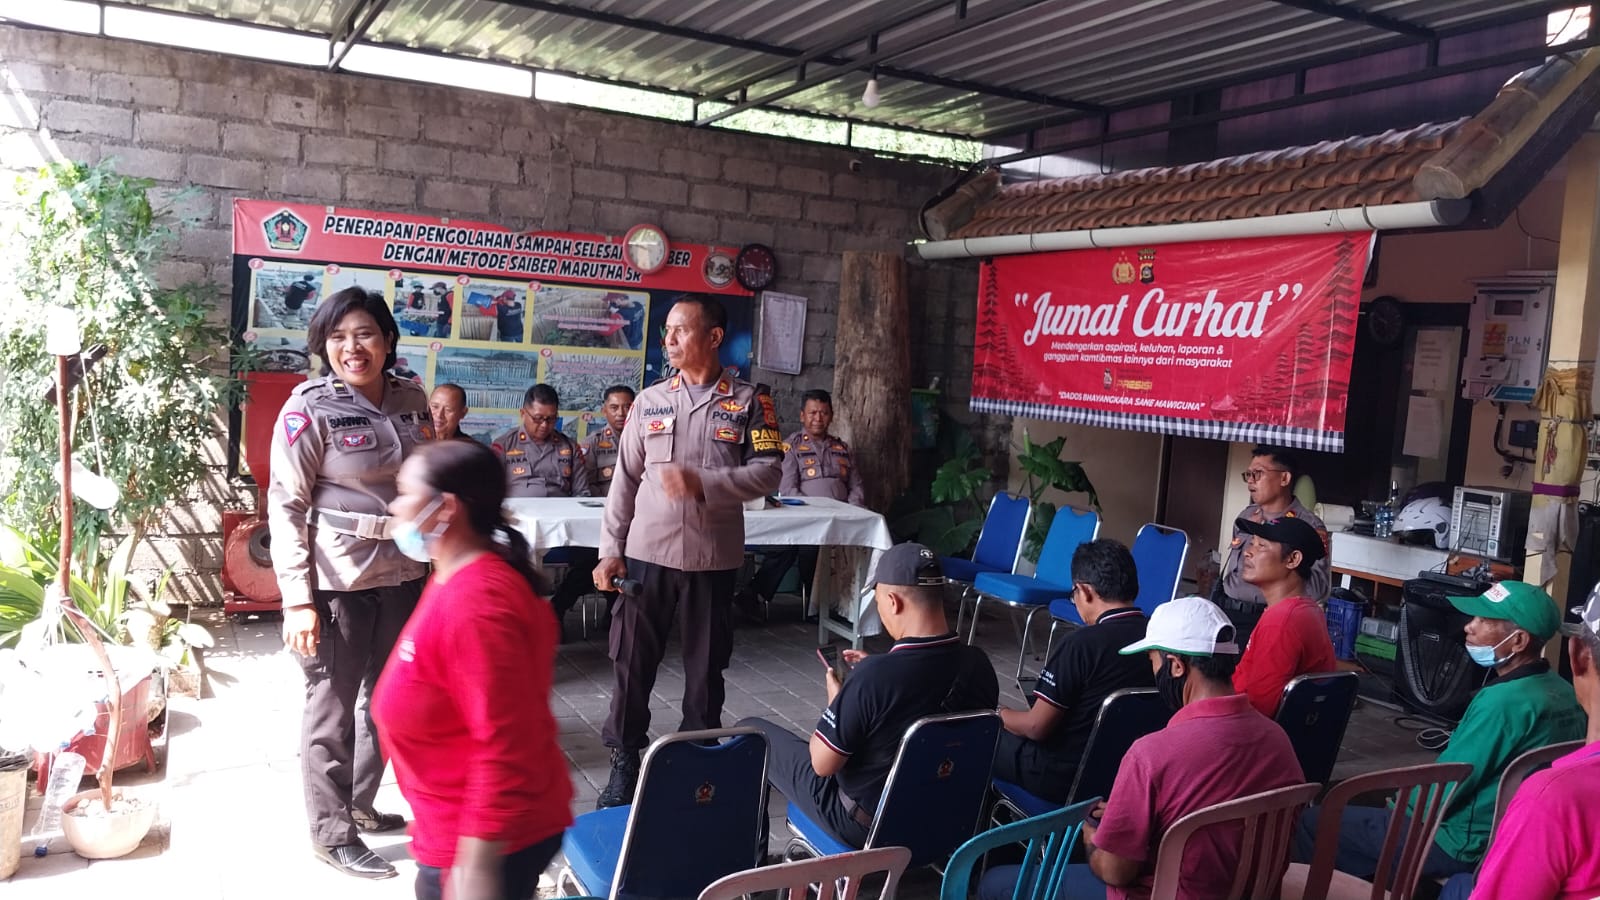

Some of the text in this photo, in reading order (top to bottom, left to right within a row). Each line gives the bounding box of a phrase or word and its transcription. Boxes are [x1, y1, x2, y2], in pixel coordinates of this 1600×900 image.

[323, 215, 413, 240] PENERAPAN
[415, 225, 514, 251] PENGOLAHAN
[515, 235, 572, 255] SAMPAH
[574, 241, 623, 259] SELESAI
[383, 243, 445, 264] DENGAN
[446, 250, 506, 271] METODE
[508, 255, 557, 274] SAIBER
[559, 262, 624, 281] MARUTHA
[1051, 341, 1224, 356] Mendengarkan aspirasi, keluhan, laporan &
[1043, 352, 1079, 363] gangguan
[1123, 354, 1154, 367] lainnya
[1155, 356, 1175, 366] dari
[1176, 358, 1233, 369] masyarakat
[643, 405, 674, 416] SUJANA
[1134, 398, 1155, 407] SANE
[711, 410, 749, 426] POLRI
